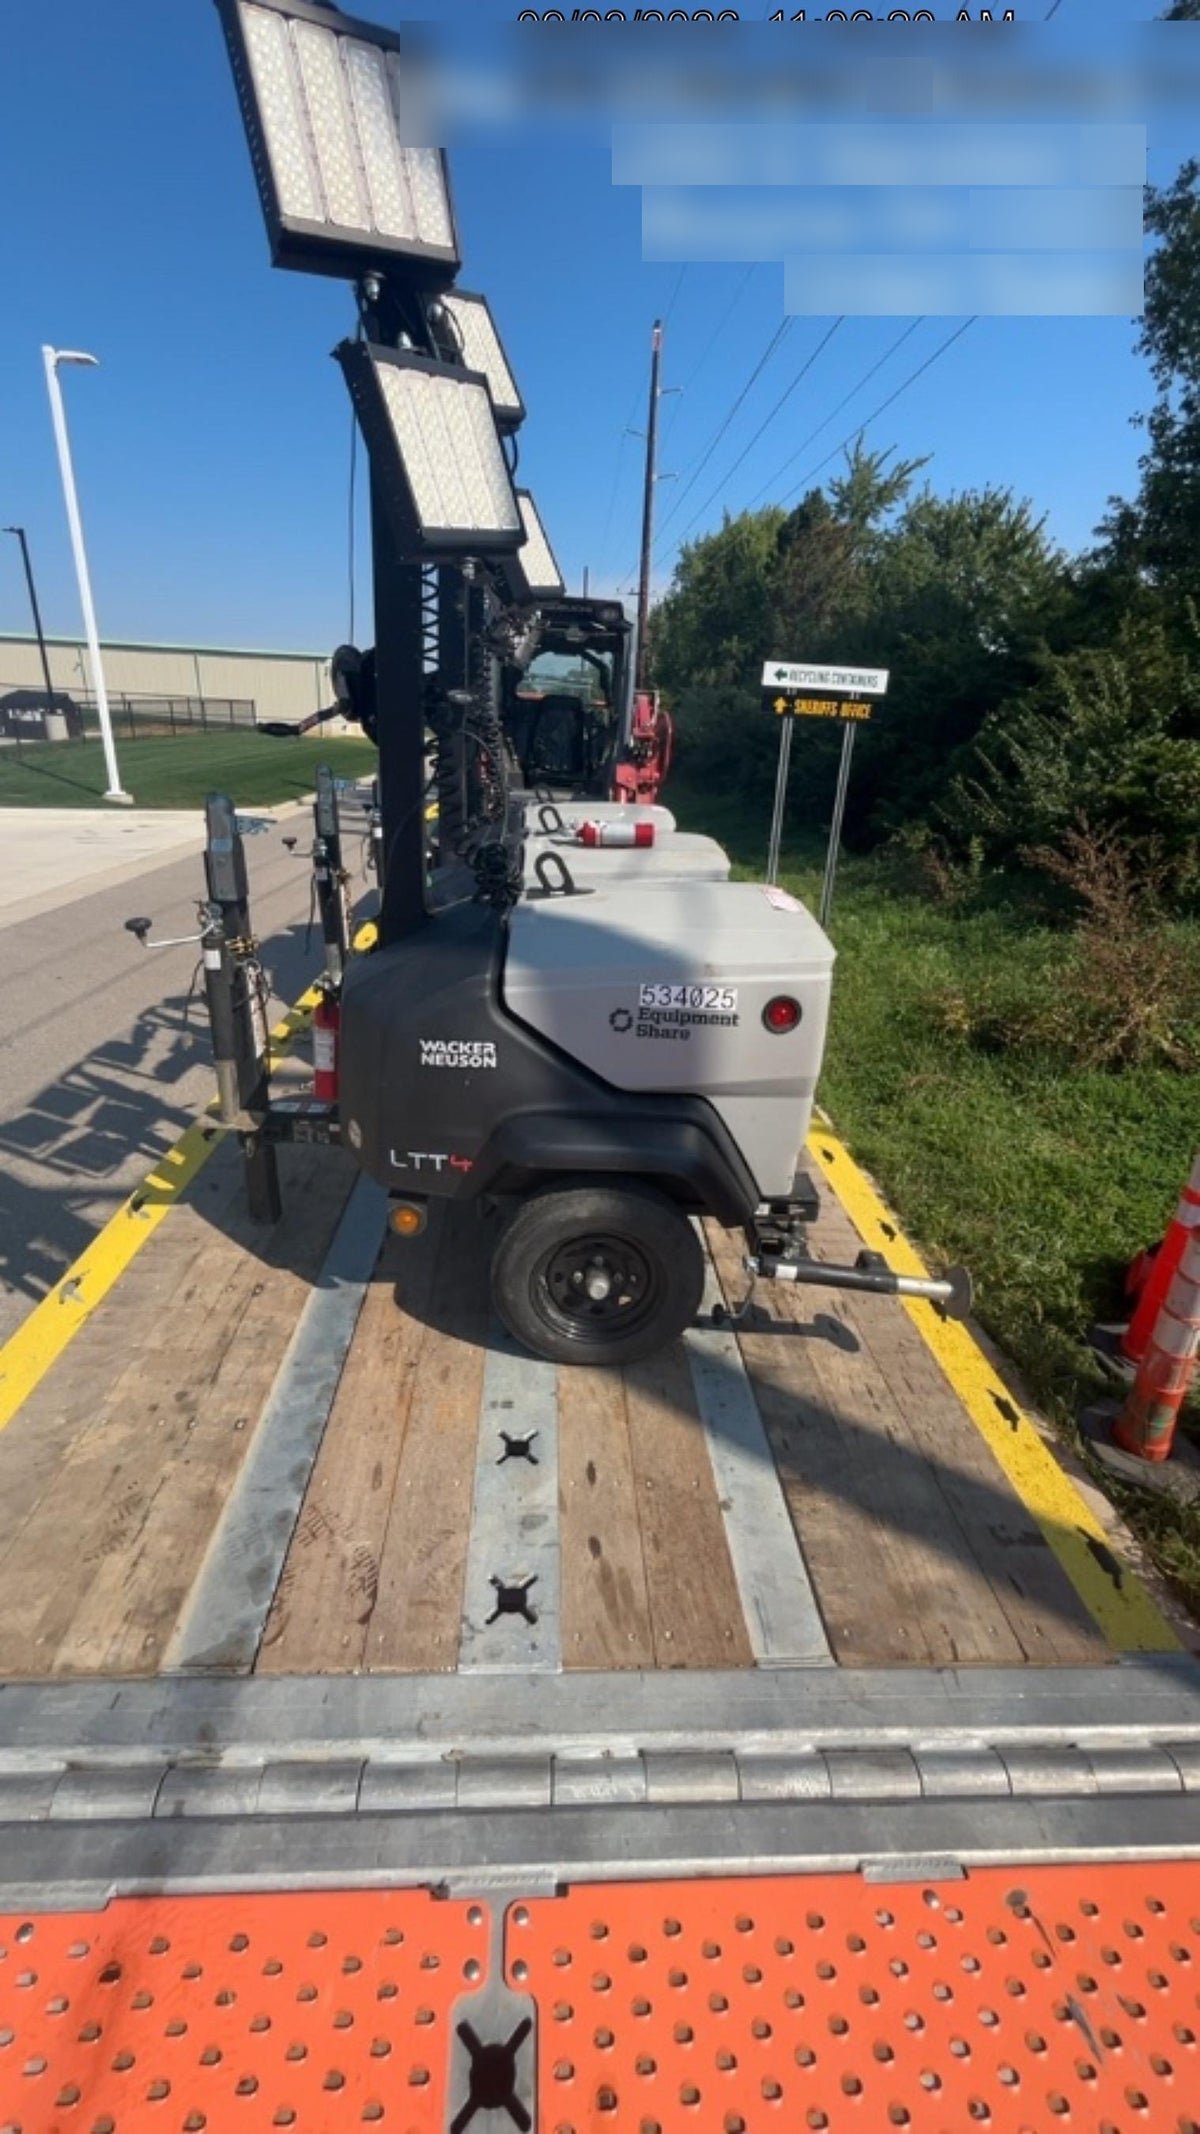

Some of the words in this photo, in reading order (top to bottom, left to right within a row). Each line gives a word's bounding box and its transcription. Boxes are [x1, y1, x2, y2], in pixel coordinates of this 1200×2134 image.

[840, 702, 872, 719] OFFICE
[641, 985, 736, 1009] 534025
[637, 1007, 740, 1027] Equipment
[635, 1024, 691, 1040] Share
[419, 1039, 496, 1054] WACKER
[421, 1053, 497, 1068] NEUSON
[390, 1149, 473, 1172] LTT4
